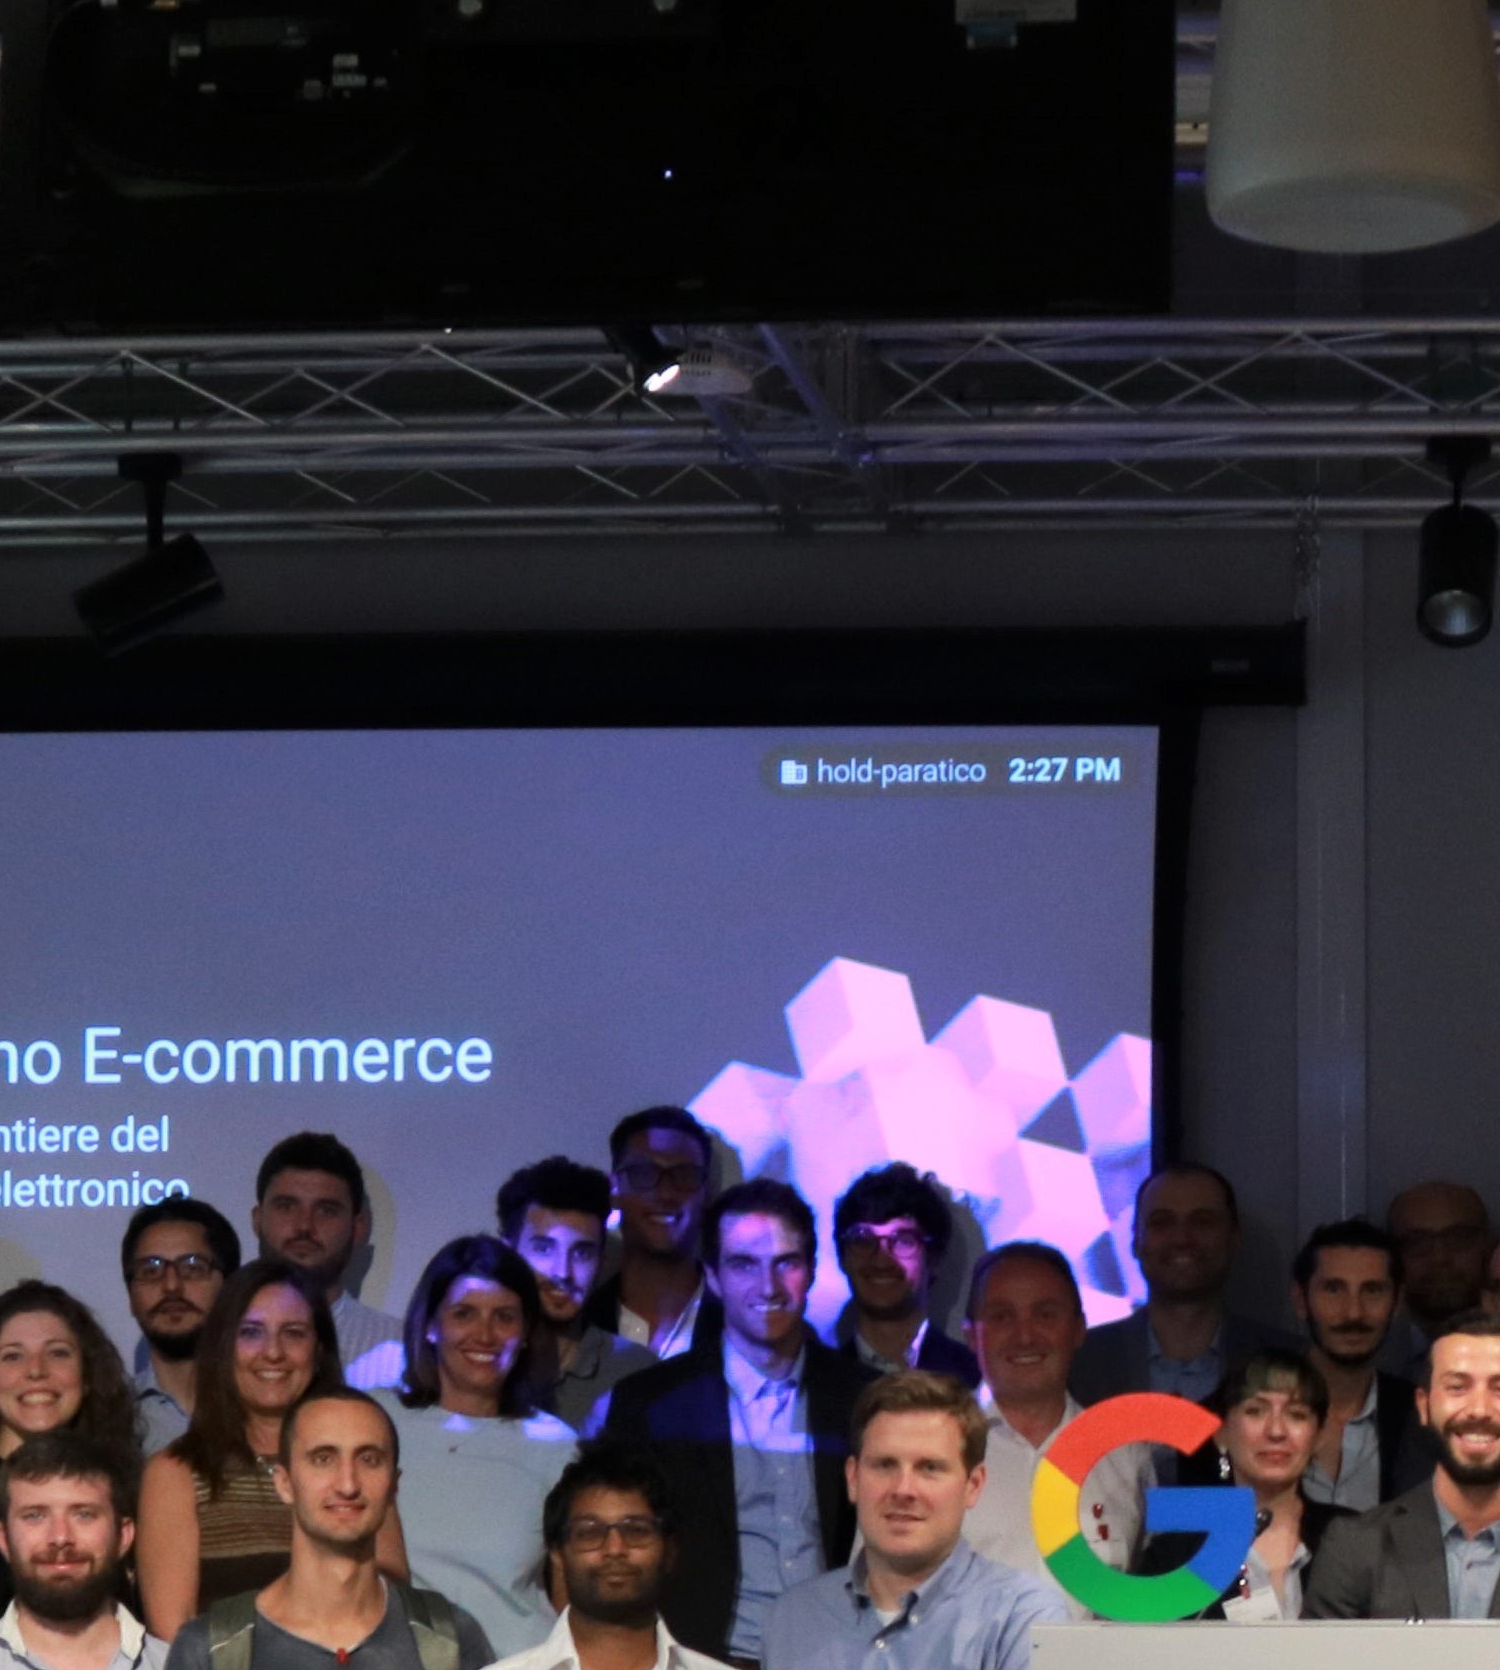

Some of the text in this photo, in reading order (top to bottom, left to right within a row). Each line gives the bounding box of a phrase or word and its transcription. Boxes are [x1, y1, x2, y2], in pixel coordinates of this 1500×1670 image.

[816, 756, 1122, 789] hold-paratico 2:27 PM
[83, 1025, 494, 1085] E-commerce
[109, 1114, 170, 1154] del
